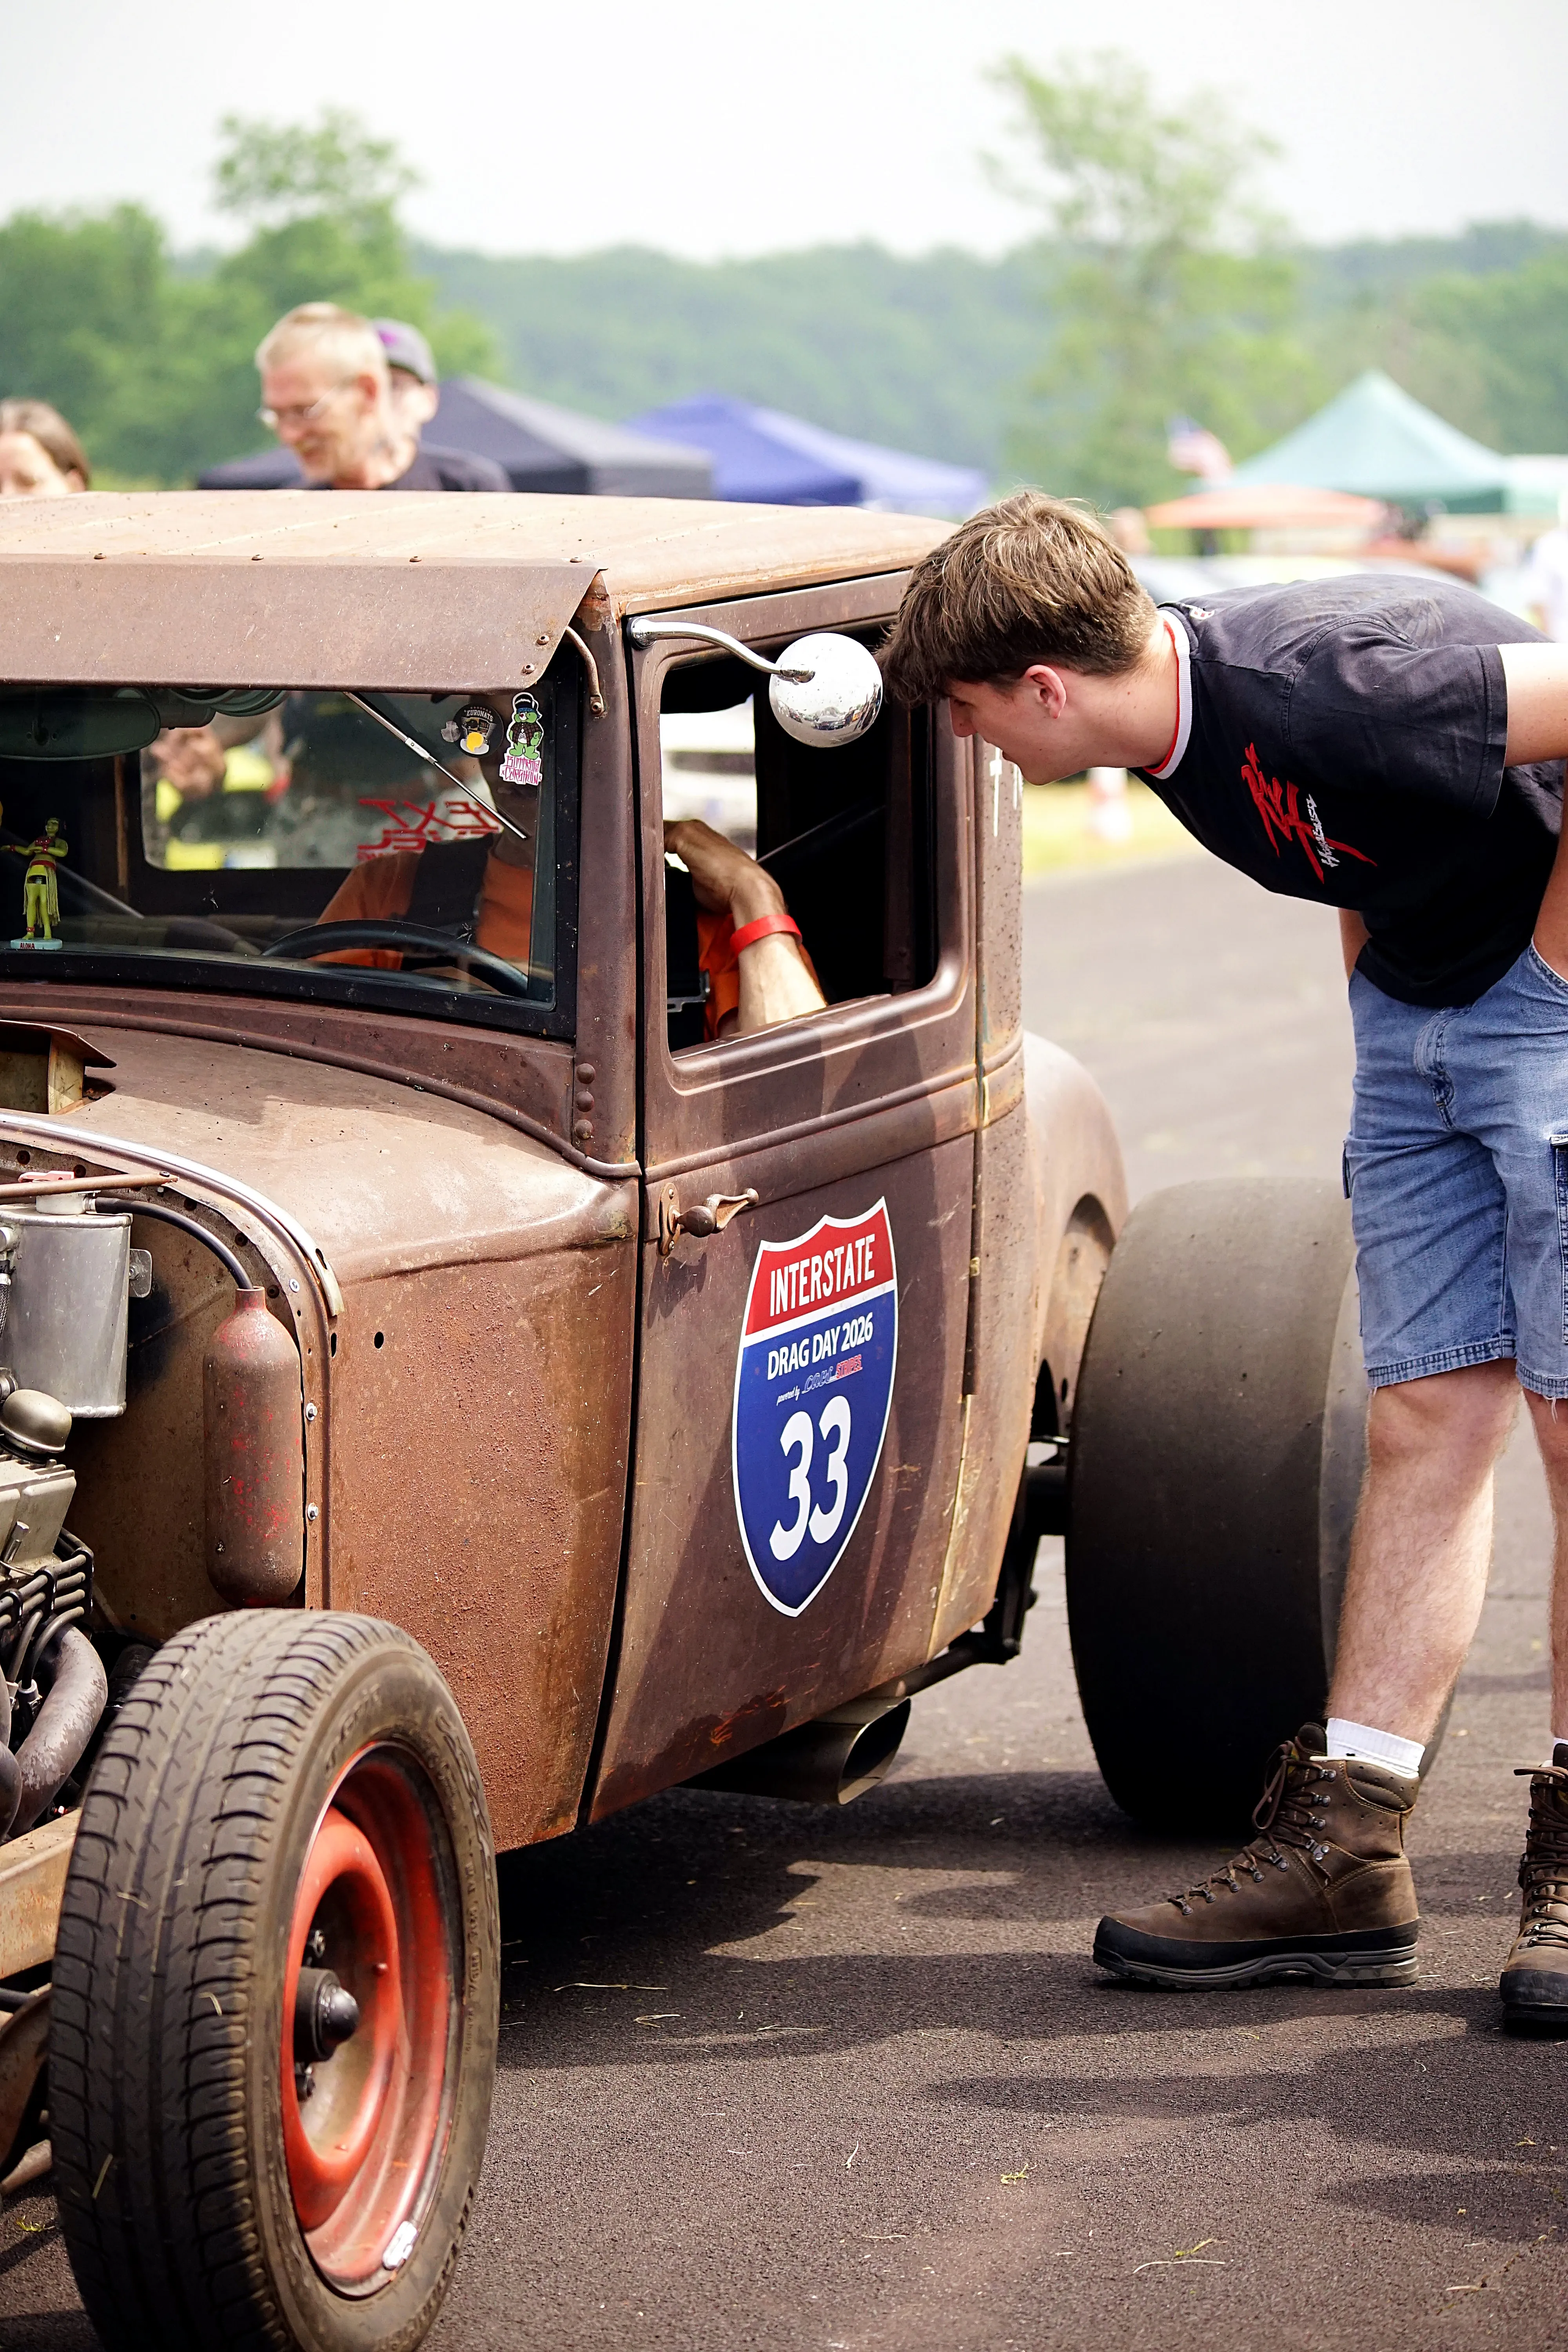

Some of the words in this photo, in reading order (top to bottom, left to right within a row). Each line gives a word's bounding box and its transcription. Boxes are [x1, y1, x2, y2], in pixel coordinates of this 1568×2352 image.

[466, 710, 493, 722] EURONATS
[770, 1234, 875, 1317] INTERSTATE
[768, 1338, 809, 1380] DRAG
[812, 1326, 841, 1363] DAY
[841, 1312, 873, 1352] 2026
[776, 1387, 795, 1406] powered
[795, 1385, 800, 1401] by
[836, 1354, 862, 1379] STRIPES
[769, 1396, 851, 1561] 33
